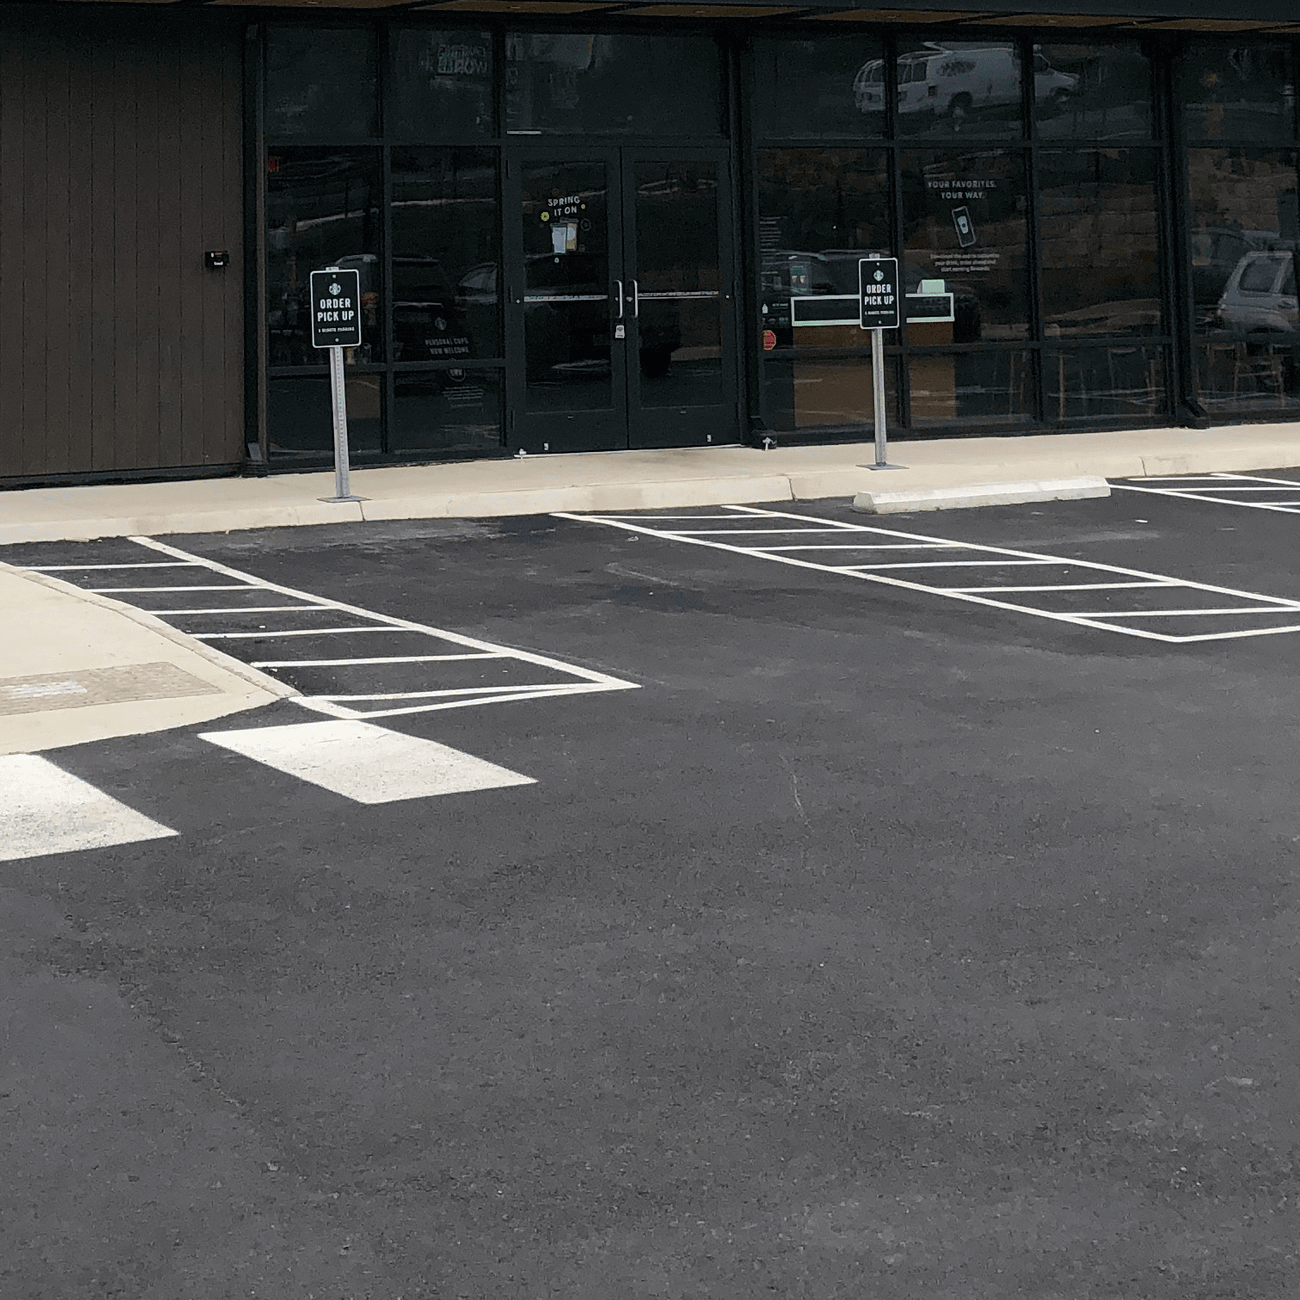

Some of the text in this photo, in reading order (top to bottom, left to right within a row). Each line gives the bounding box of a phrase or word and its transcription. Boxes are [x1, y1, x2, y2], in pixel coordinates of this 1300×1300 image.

[547, 196, 581, 206] SPRING
[554, 205, 577, 216] IT ON
[866, 284, 891, 294] ORDER
[320, 298, 351, 309] ORDER
[864, 296, 894, 305] PICK UP
[317, 310, 354, 322] PICK UP
